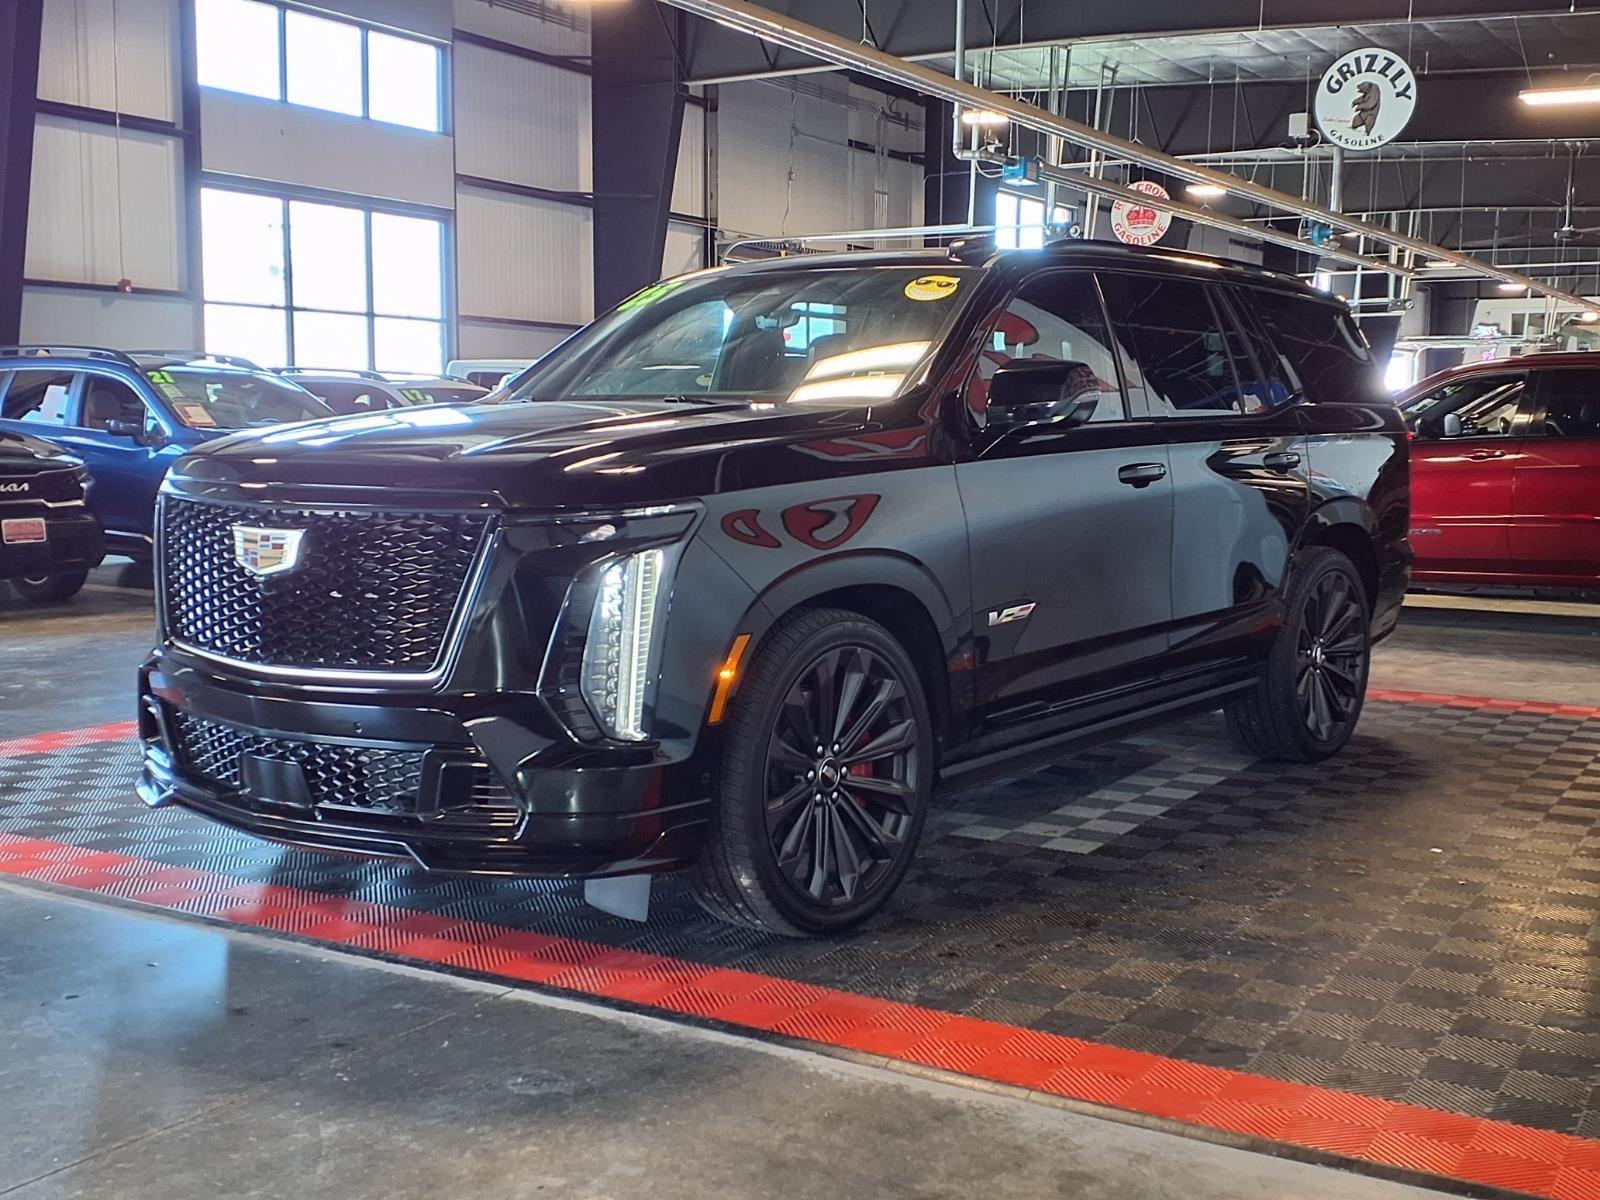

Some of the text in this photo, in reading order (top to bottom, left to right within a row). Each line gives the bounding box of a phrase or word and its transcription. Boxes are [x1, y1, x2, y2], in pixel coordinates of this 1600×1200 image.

[1326, 53, 1412, 101] GRIZZLY
[1329, 129, 1385, 147] GASOLINE
[1135, 183, 1166, 200] CRO
[1114, 222, 1167, 245] GASOLINE
[146, 371, 175, 384] 21
